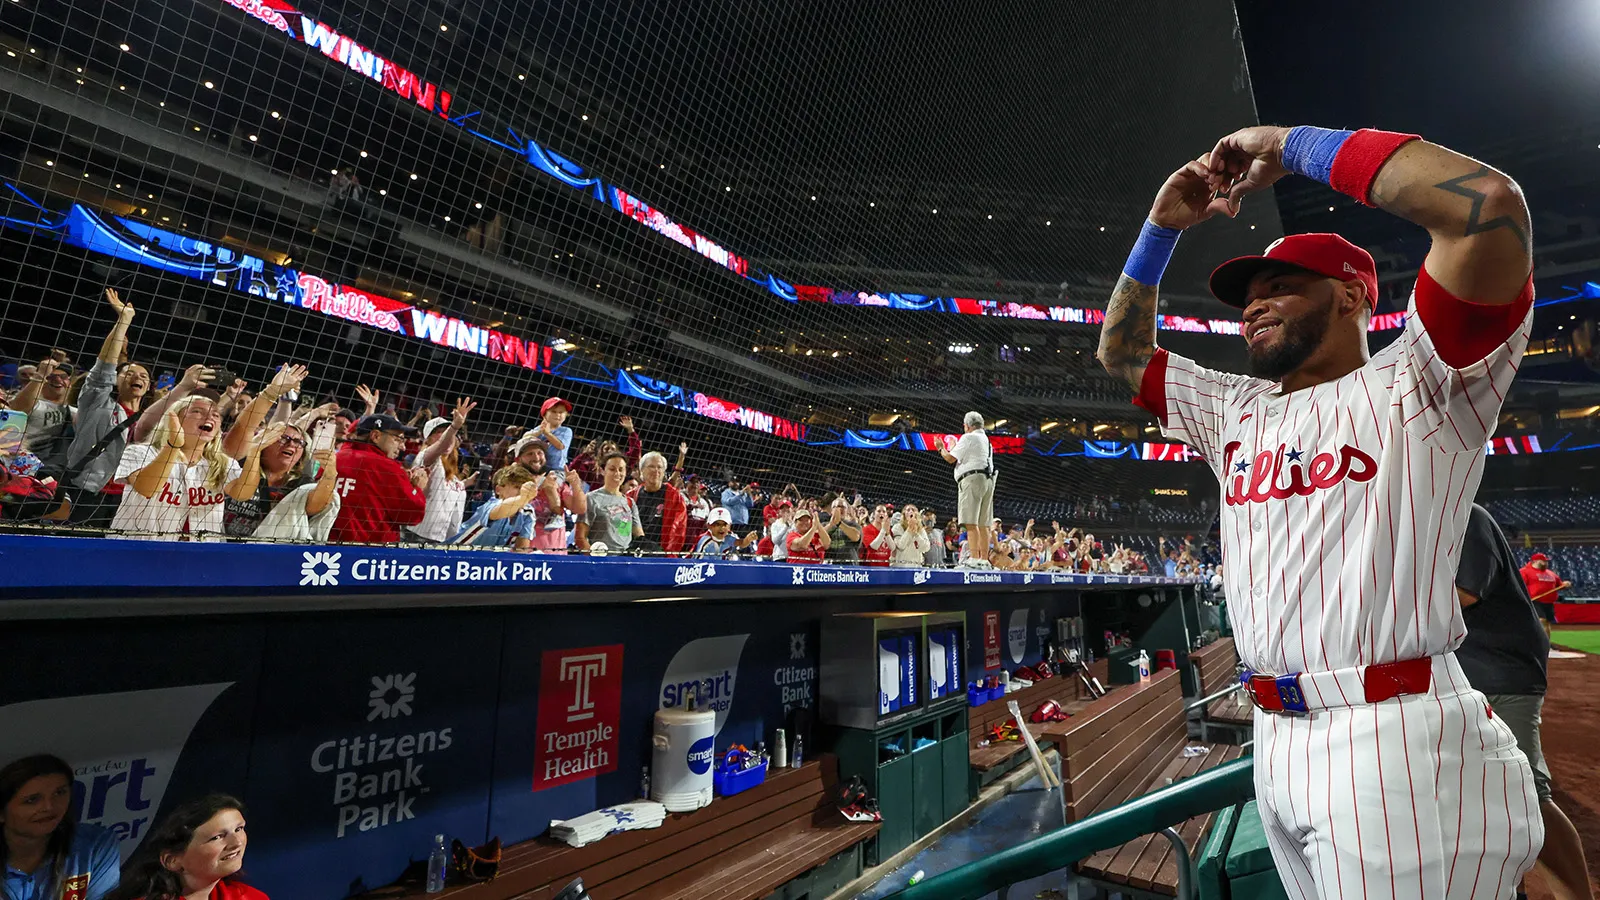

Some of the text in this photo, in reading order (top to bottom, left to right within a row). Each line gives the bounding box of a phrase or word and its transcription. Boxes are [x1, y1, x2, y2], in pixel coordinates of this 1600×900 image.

[298, 272, 400, 332] Phillies
[411, 309, 489, 355] WIN!
[351, 559, 552, 581] Citizens Bank Park
[806, 570, 870, 583] Citizens Bank Park
[662, 670, 732, 708] smart
[774, 666, 814, 686] Citizen
[708, 699, 731, 713] ater
[781, 681, 810, 704] Bank
[310, 727, 452, 773] Citizens
[544, 723, 613, 753] Temple
[543, 747, 609, 781] Health
[687, 747, 713, 762] smart
[333, 757, 423, 805] Bank
[337, 791, 417, 838] Park
